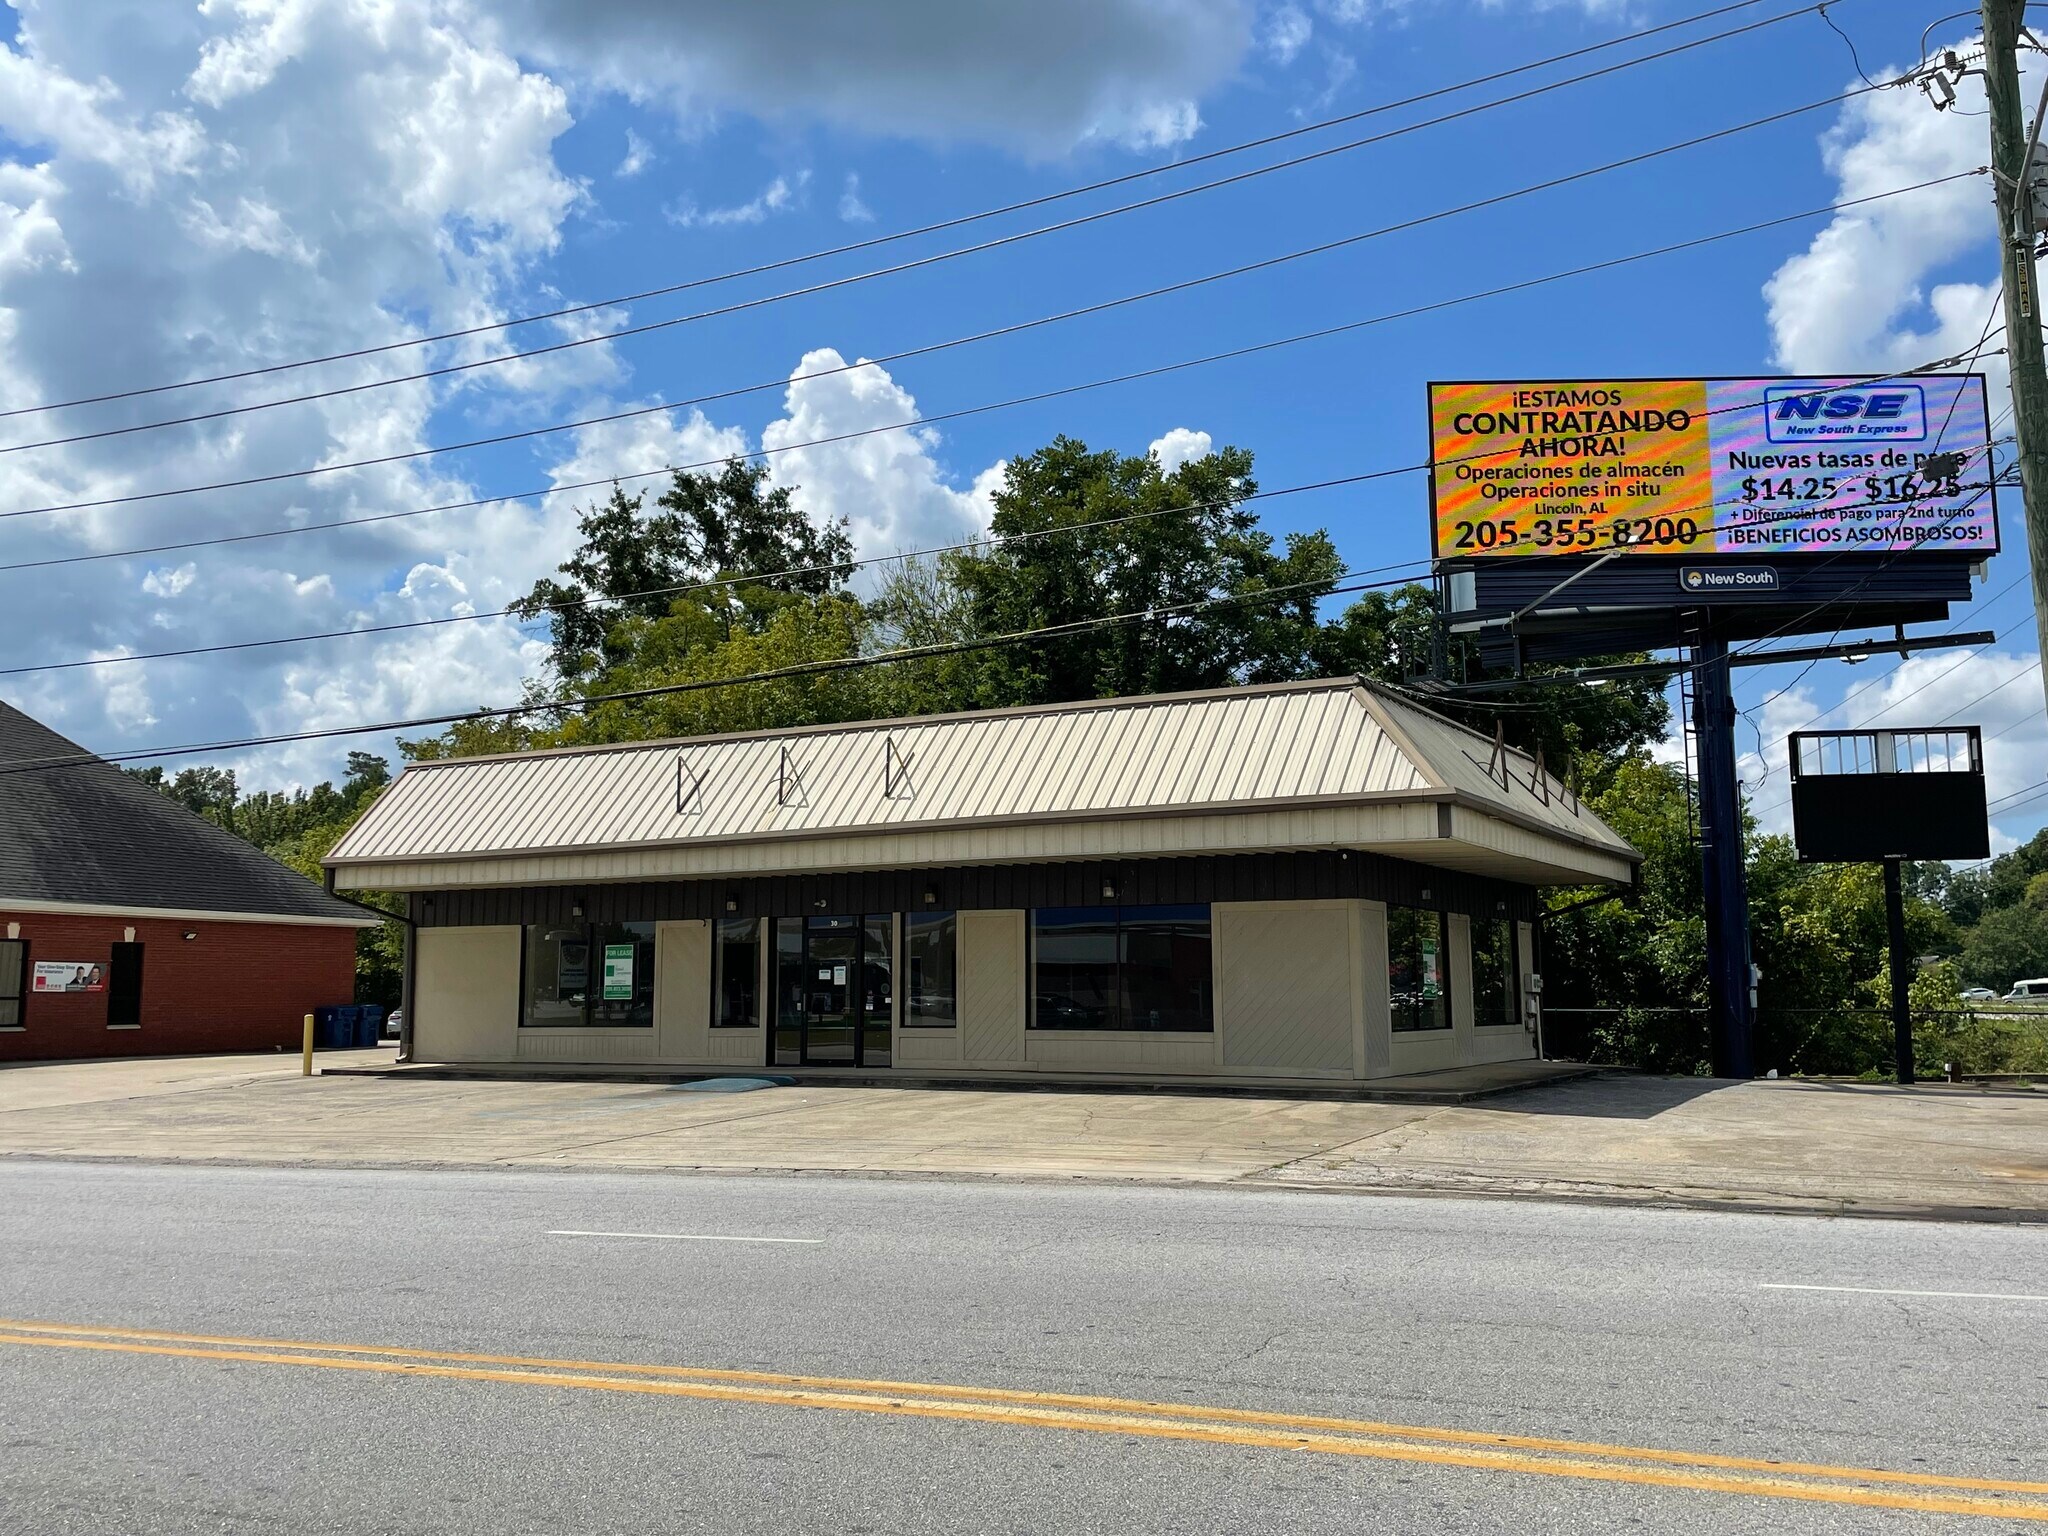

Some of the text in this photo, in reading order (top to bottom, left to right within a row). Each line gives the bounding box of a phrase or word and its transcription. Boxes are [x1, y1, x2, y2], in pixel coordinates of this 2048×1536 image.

[1513, 390, 1622, 408] ¡ESTAMOS
[1775, 394, 1909, 420] NSE
[1453, 409, 1691, 434] CONTRATANDO
[1786, 424, 1908, 435] New South Express
[1519, 436, 1626, 458] AHORA!
[1729, 451, 1812, 469] Nuevas
[1818, 452, 1875, 469] tasas
[1880, 448, 1908, 467] de
[1455, 461, 1685, 483] Operaciones de almacén
[1480, 482, 1661, 501] Operaciones in situ
[1742, 475, 1838, 502] $14.25
[1535, 502, 1608, 516] Lincoln, AL
[1730, 511, 1739, 520] +
[1820, 508, 1836, 520] de
[1840, 509, 1873, 522] pago
[1876, 509, 1906, 522] para
[1909, 506, 1934, 519] 2nd
[1937, 507, 1975, 518] turno
[1454, 518, 1698, 548] 205-355-8200
[1728, 526, 1983, 545] ¡BENEFICIOS ASOMBROSOS!
[1705, 571, 1774, 585] New South
